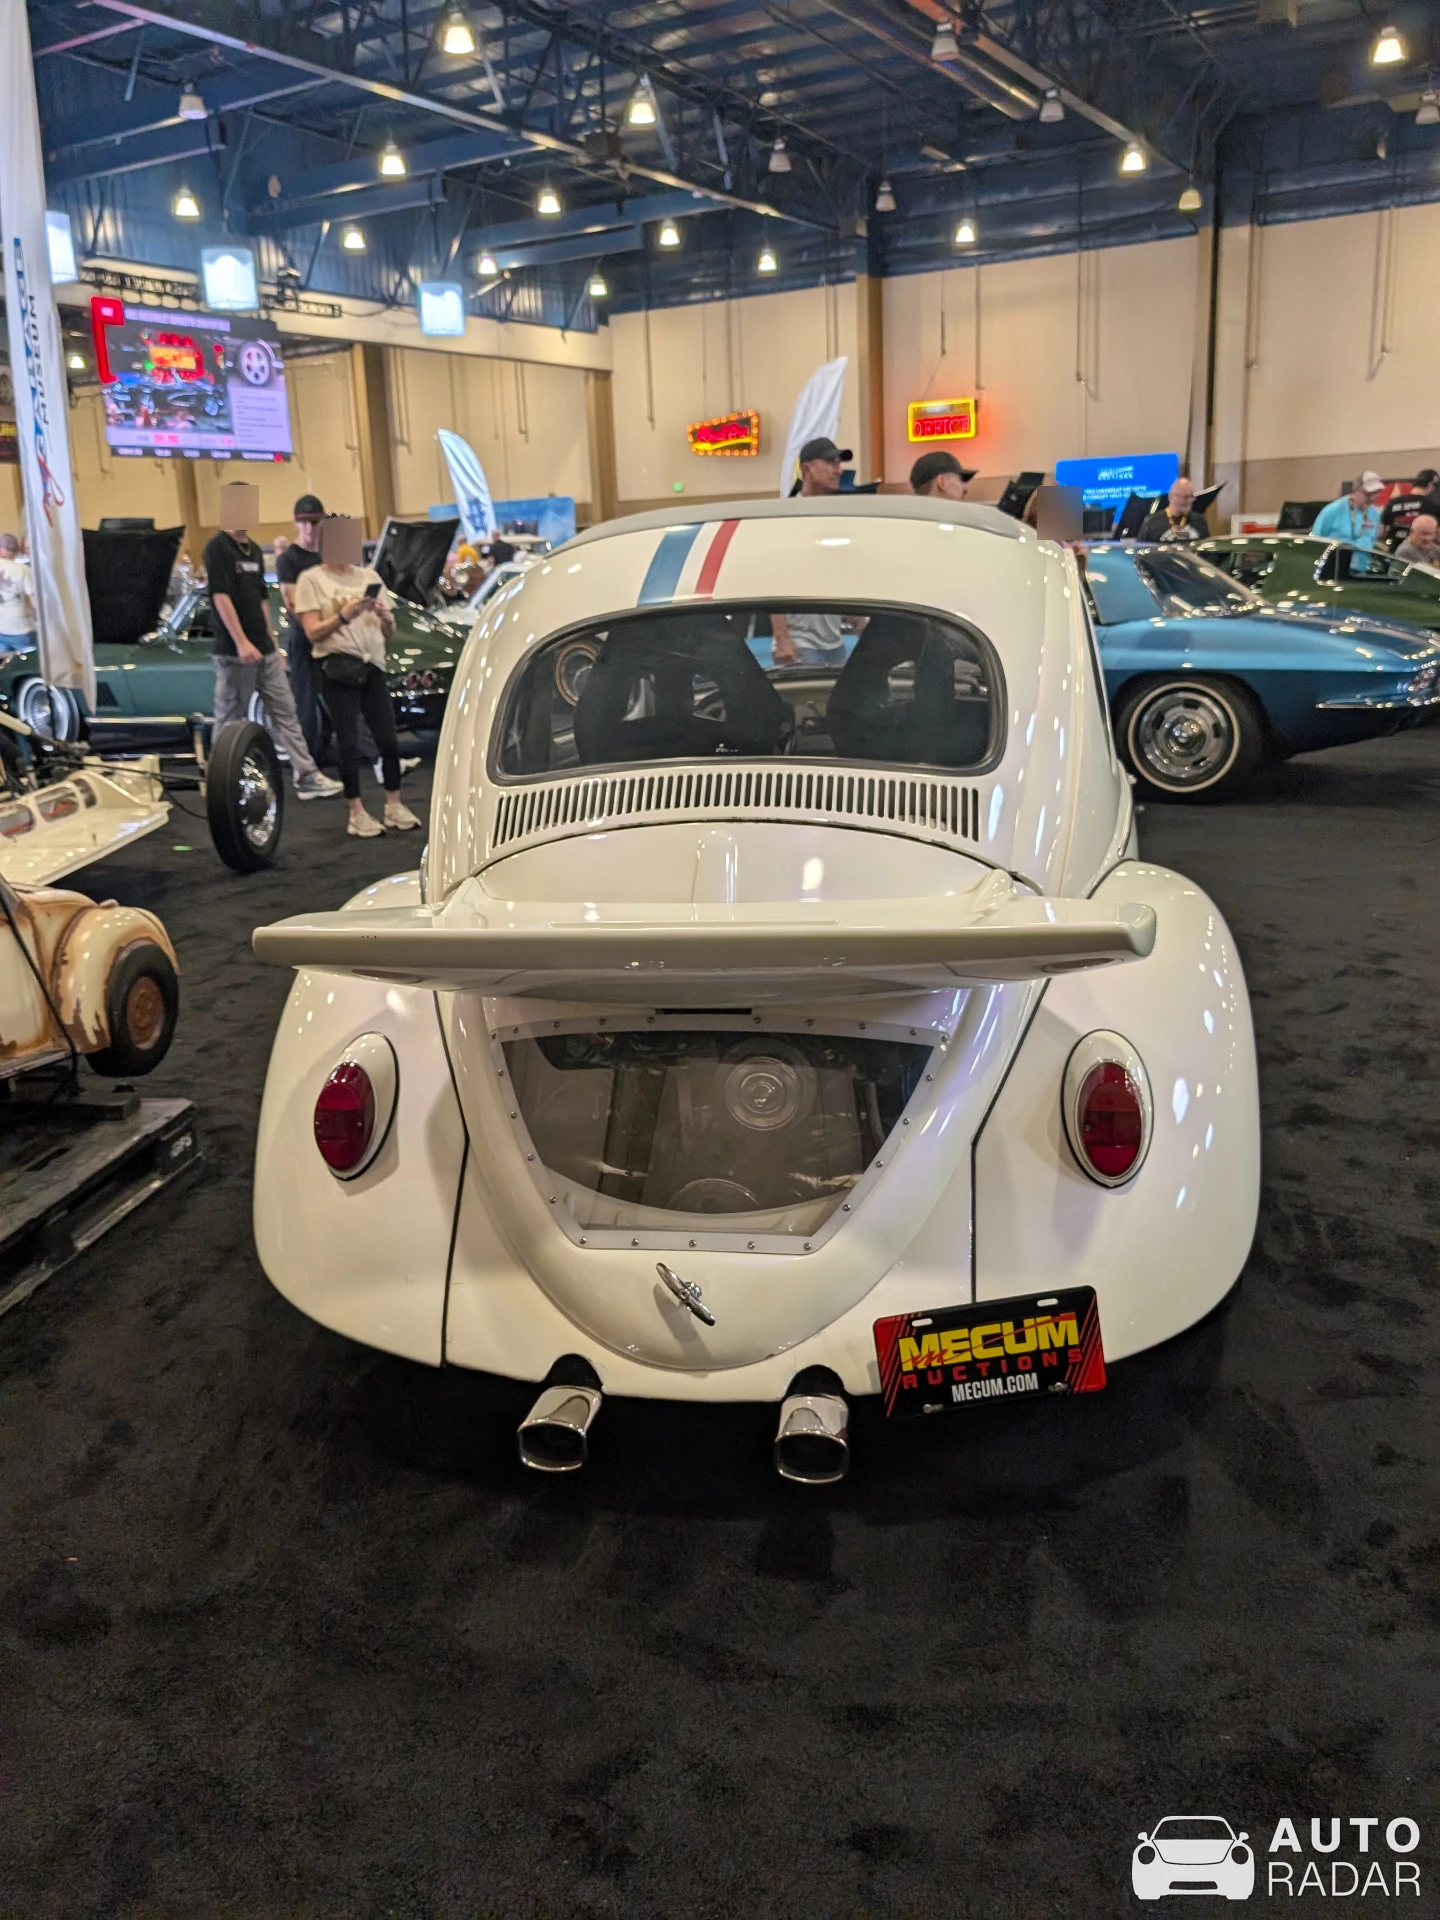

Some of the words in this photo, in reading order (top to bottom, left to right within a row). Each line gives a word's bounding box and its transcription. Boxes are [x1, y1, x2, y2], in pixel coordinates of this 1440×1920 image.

[28, 295, 50, 426] MUSEUM
[914, 415, 969, 437] OFFICE
[898, 1313, 1079, 1372] MECUM
[902, 1348, 1084, 1390] AUCTIONS
[951, 1372, 1039, 1403] MECUM.COM
